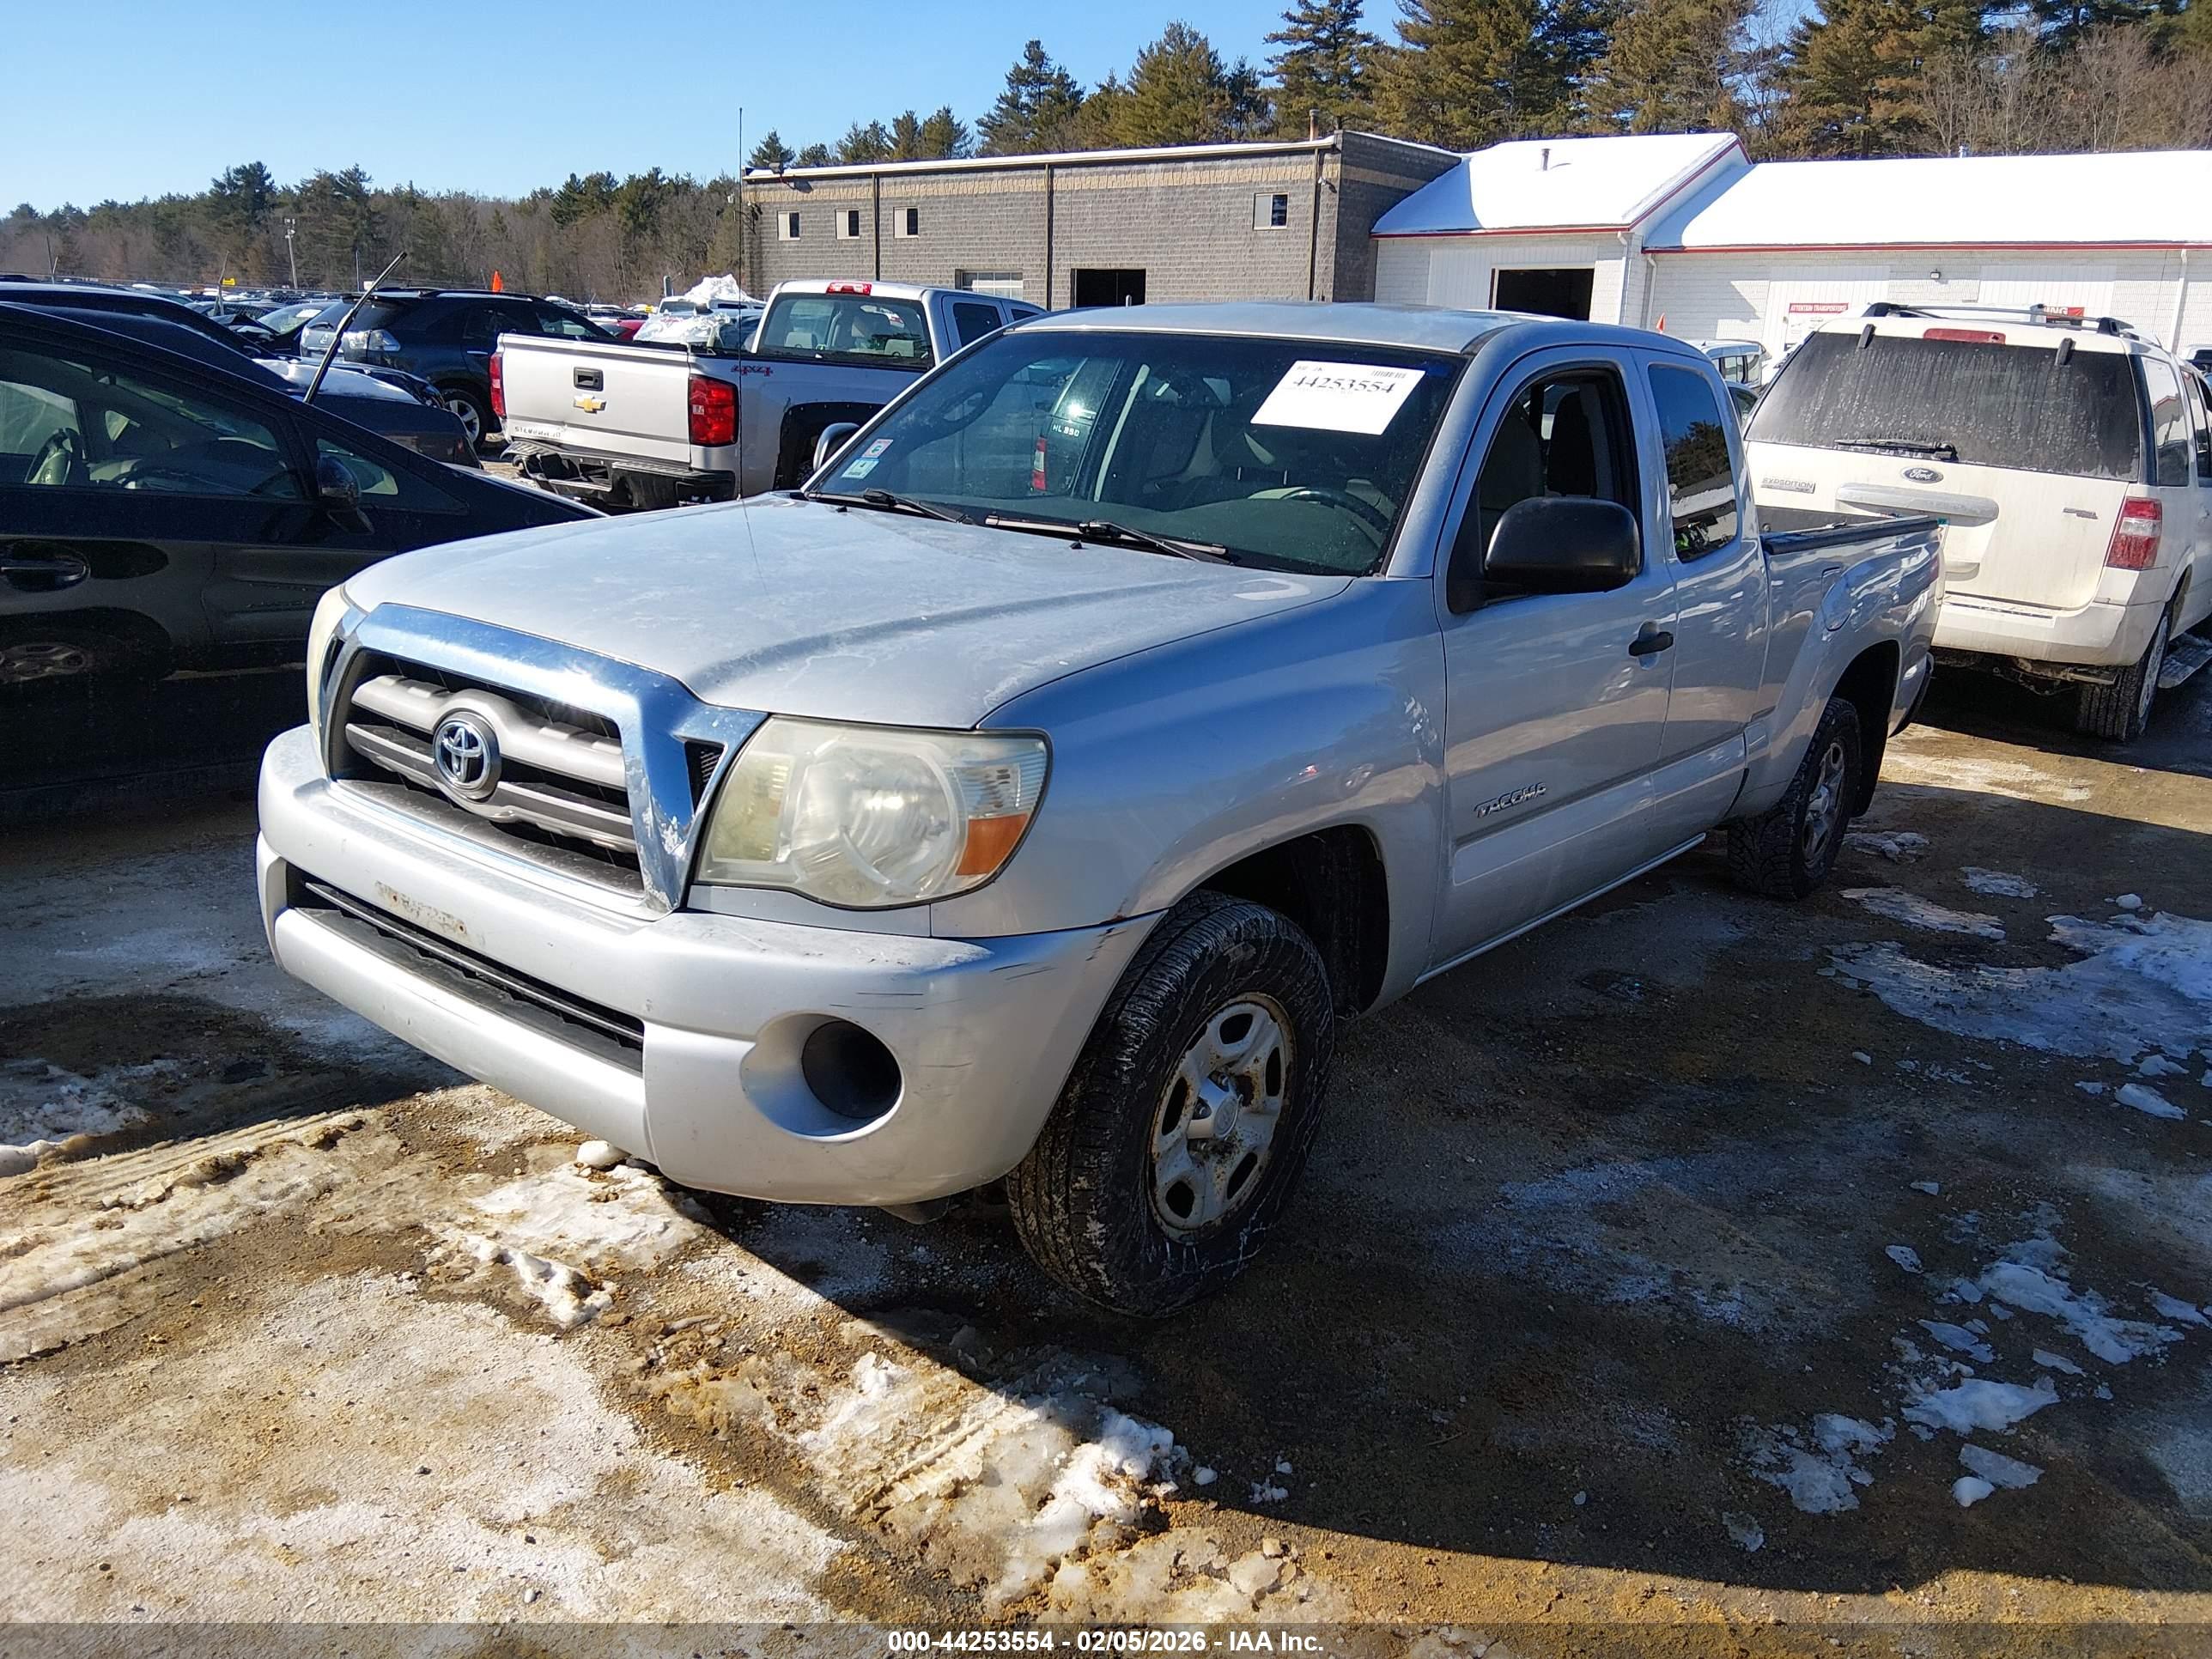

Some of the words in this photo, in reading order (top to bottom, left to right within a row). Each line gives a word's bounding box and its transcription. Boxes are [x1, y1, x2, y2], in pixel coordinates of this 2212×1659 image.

[1292, 375, 1395, 393] 44253554
[1909, 468, 1934, 479] Ford
[1761, 477, 1814, 489] EXPEDITION
[1473, 781, 1547, 817] TACOMA
